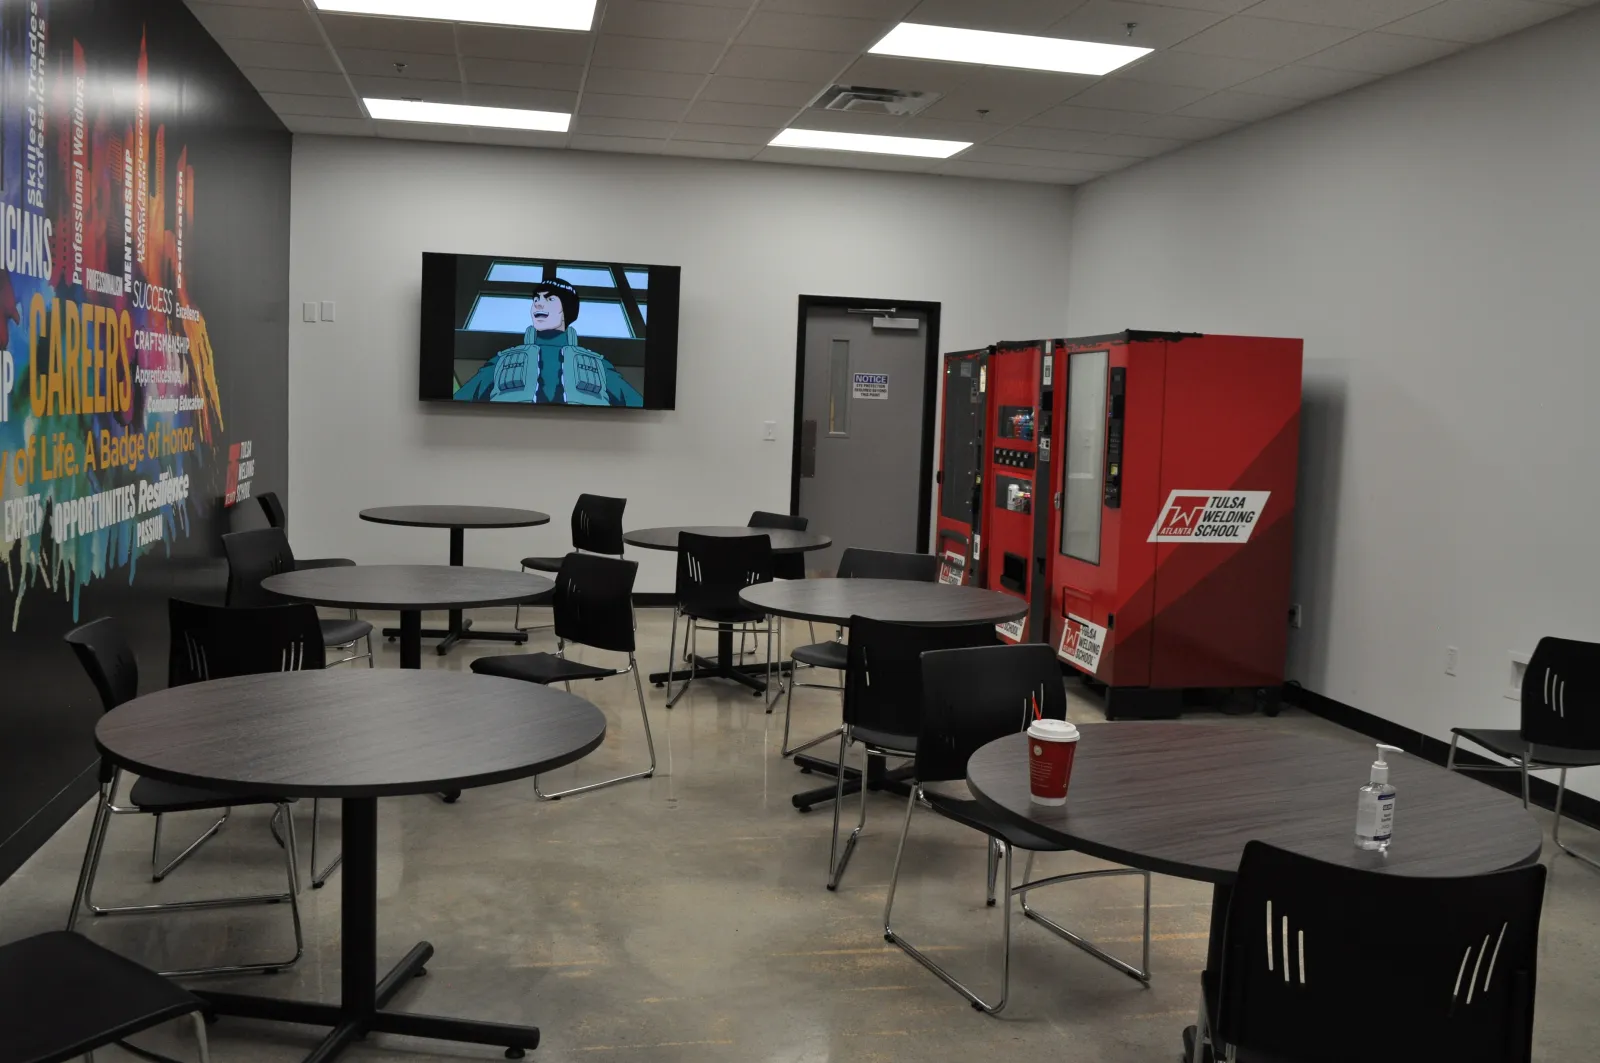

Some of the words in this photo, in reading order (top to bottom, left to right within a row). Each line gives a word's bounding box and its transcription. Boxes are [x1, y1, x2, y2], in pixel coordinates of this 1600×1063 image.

[28, 0, 38, 96] Trades
[35, 18, 46, 208] Professionals
[73, 76, 85, 157] Welders
[27, 106, 37, 206] Skilled
[72, 161, 84, 285] Professional
[124, 148, 133, 293] MENTORSHIP
[85, 267, 123, 297] PROFESSIONALISM
[132, 280, 173, 315] SUCCESS
[175, 302, 200, 322] Excellence
[29, 293, 131, 418] CAREERS
[134, 330, 190, 354] CRAFTSMANSHIP
[855, 375, 887, 384] NOTICE
[147, 395, 179, 415] Continuing
[179, 395, 204, 411] Education
[14, 434, 36, 487] of
[41, 431, 80, 481] Life.
[84, 430, 97, 473] A
[101, 425, 145, 471] Badge
[148, 422, 161, 459] of
[162, 424, 195, 457] Honor.
[137, 474, 189, 514] Resilience
[1210, 496, 1246, 508] TULSA
[54, 483, 136, 544] OPPORTUNITIES
[1202, 511, 1255, 523] WELDING
[137, 514, 163, 548] PASSION
[1160, 527, 1192, 535] ATLANTA
[1075, 648, 1093, 666] SCHOOL
[1078, 636, 1101, 656] WELDING
